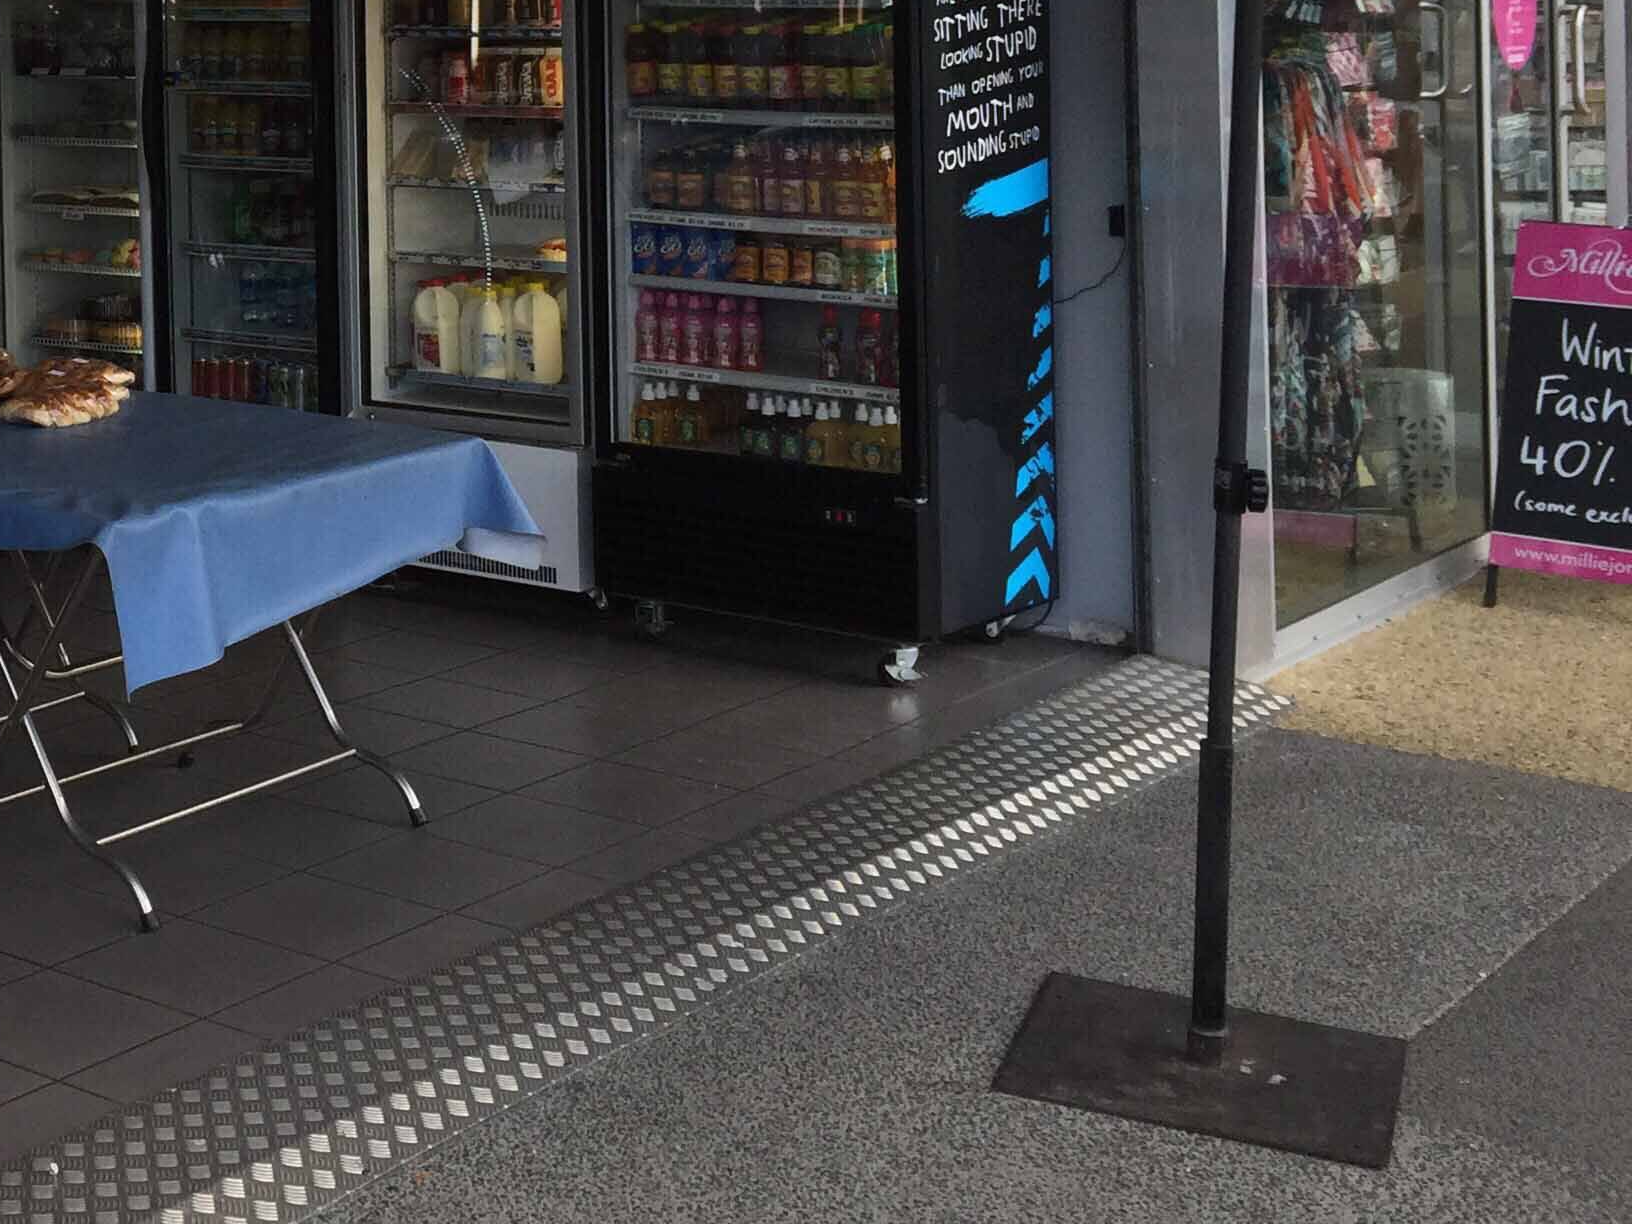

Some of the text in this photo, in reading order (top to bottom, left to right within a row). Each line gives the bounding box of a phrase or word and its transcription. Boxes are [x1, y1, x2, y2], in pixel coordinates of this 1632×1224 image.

[932, 5, 989, 43] SITTING
[940, 25, 1038, 70] LOOKING STUPID
[937, 60, 1044, 106] THAN OPENING YOUR
[946, 92, 1035, 137] MOUTH AND
[937, 125, 1041, 175] SOUNDING STUPID
[1520, 435, 1616, 486] 40%
[1514, 490, 1577, 516] (some
